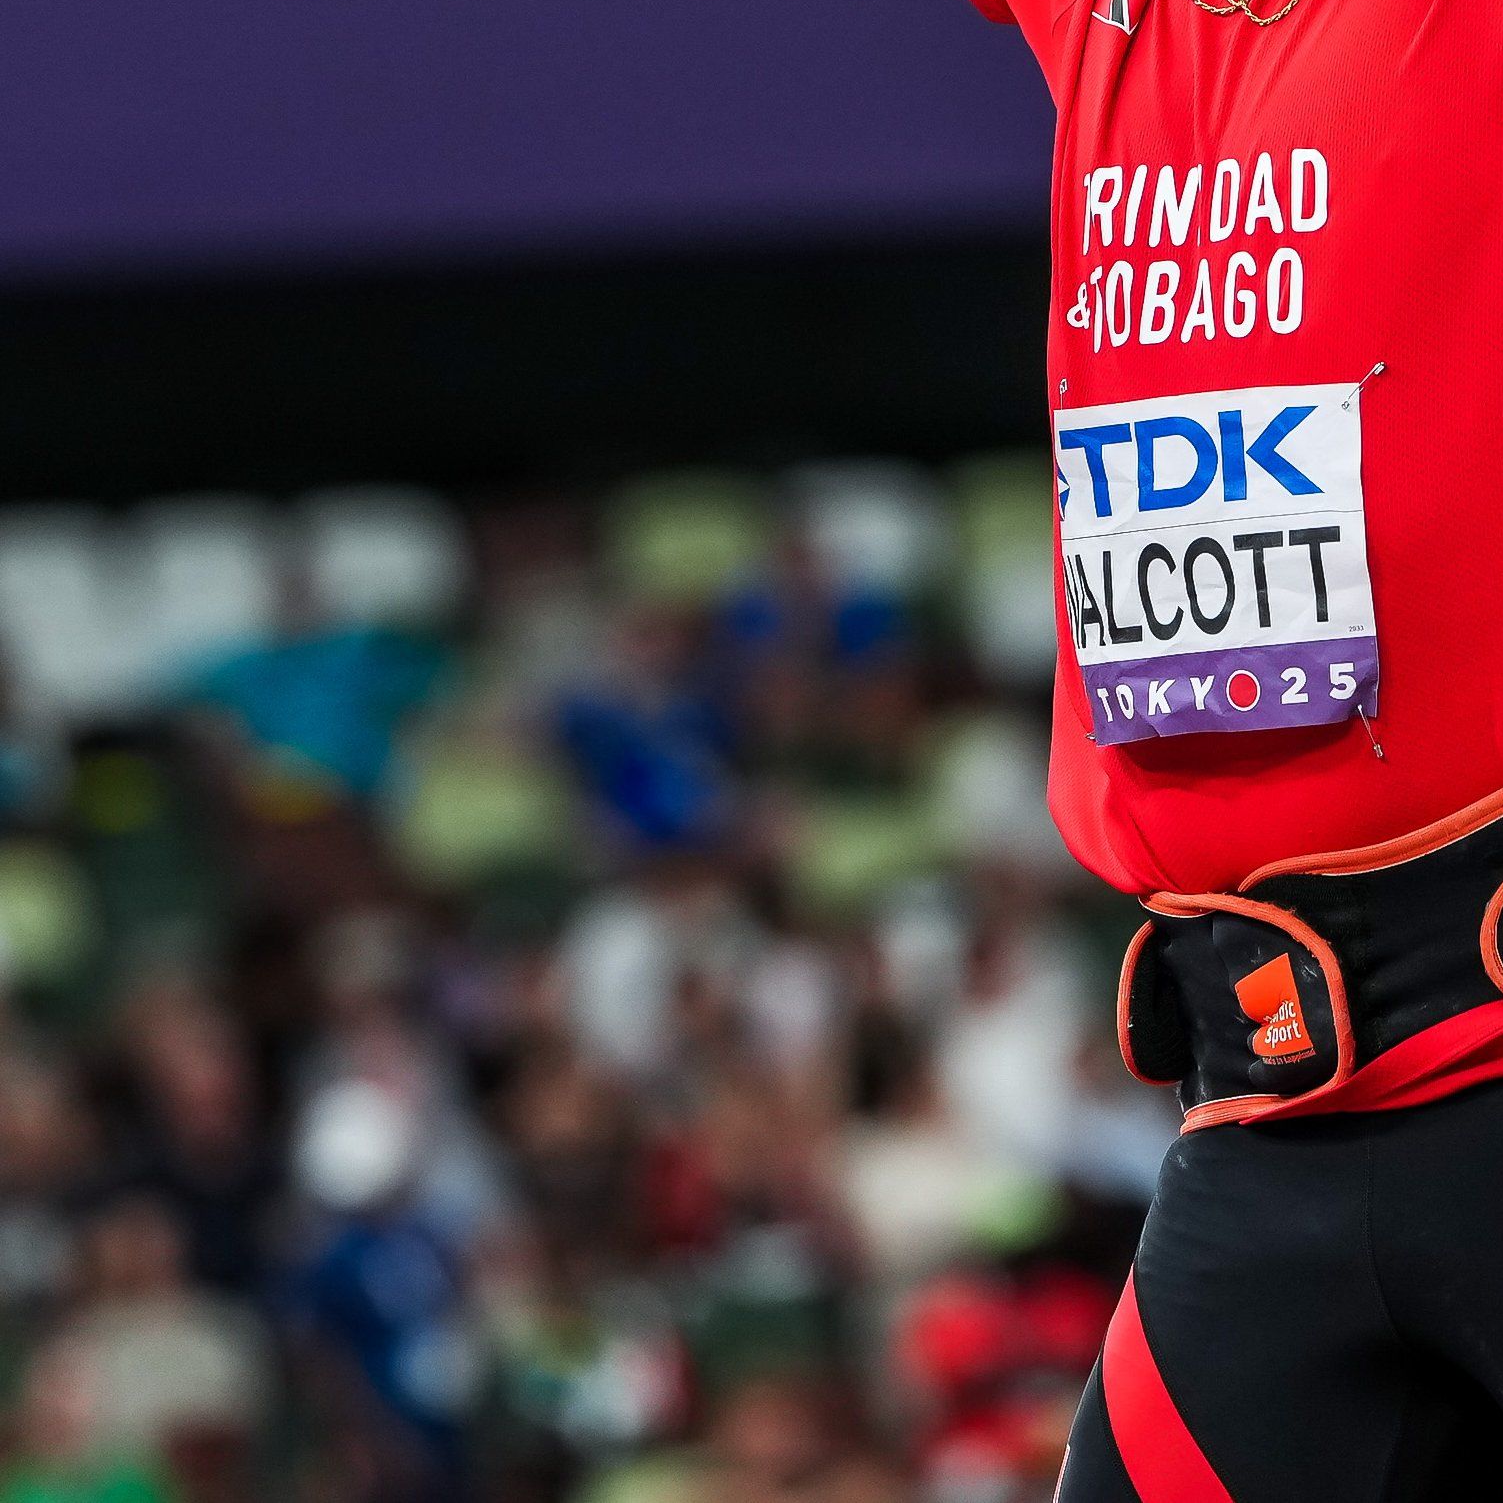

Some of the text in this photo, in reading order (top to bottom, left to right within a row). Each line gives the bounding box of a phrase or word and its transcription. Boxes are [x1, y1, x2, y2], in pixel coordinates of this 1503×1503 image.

[1082, 148, 1328, 256] TRINDAD
[1090, 247, 1303, 353] TOBAGO
[1060, 405, 1325, 518] TDK
